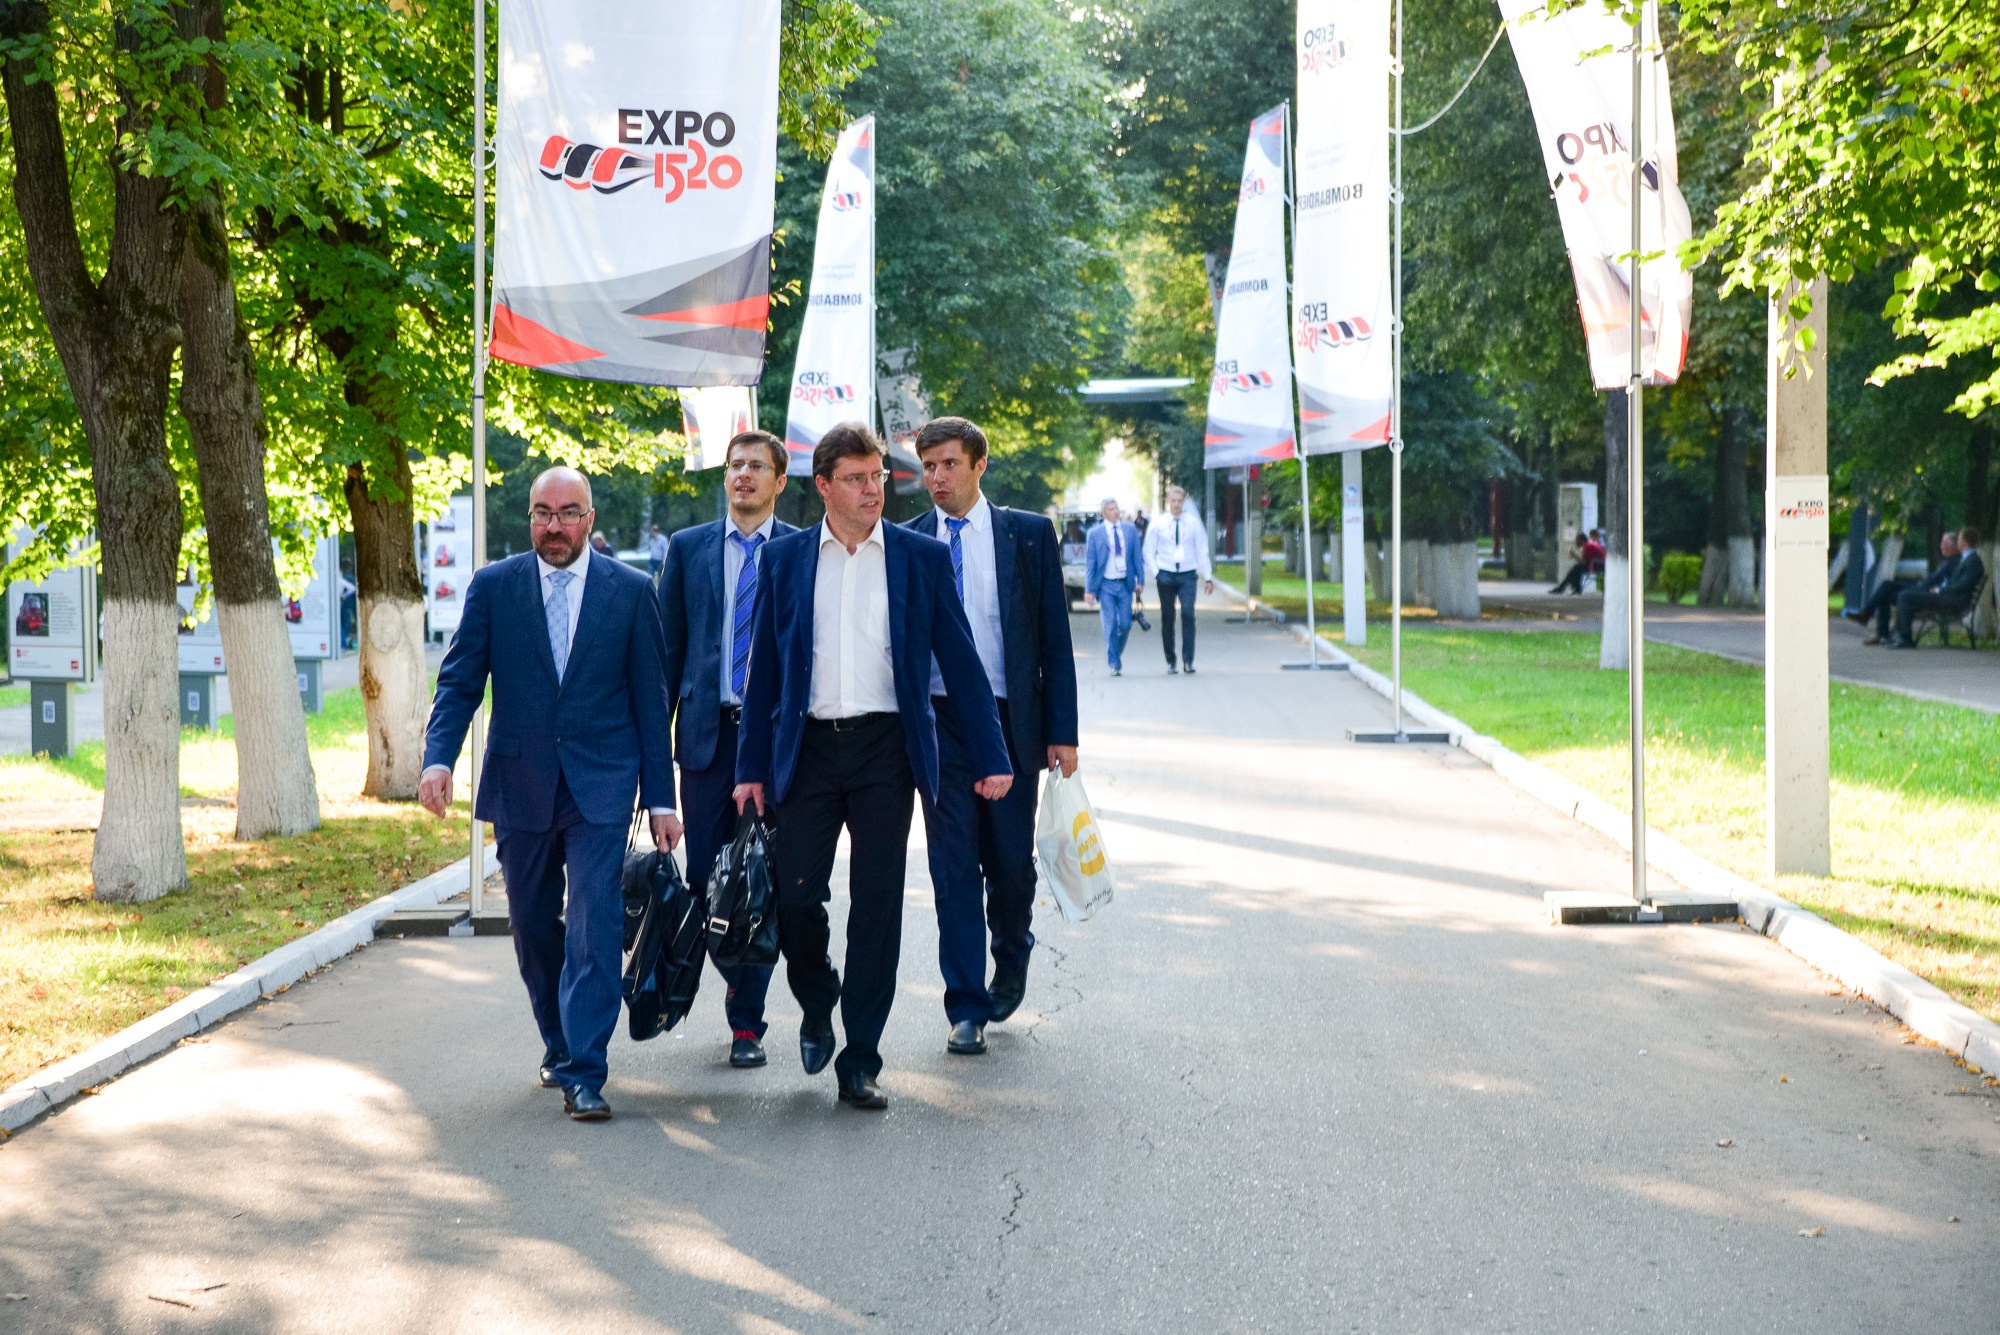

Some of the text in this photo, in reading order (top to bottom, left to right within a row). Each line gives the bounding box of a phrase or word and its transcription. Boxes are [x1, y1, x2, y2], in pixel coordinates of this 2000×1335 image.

[618, 108, 736, 147] EXPO
[654, 139, 743, 203] 1520
[1797, 500, 1823, 508] EXPO
